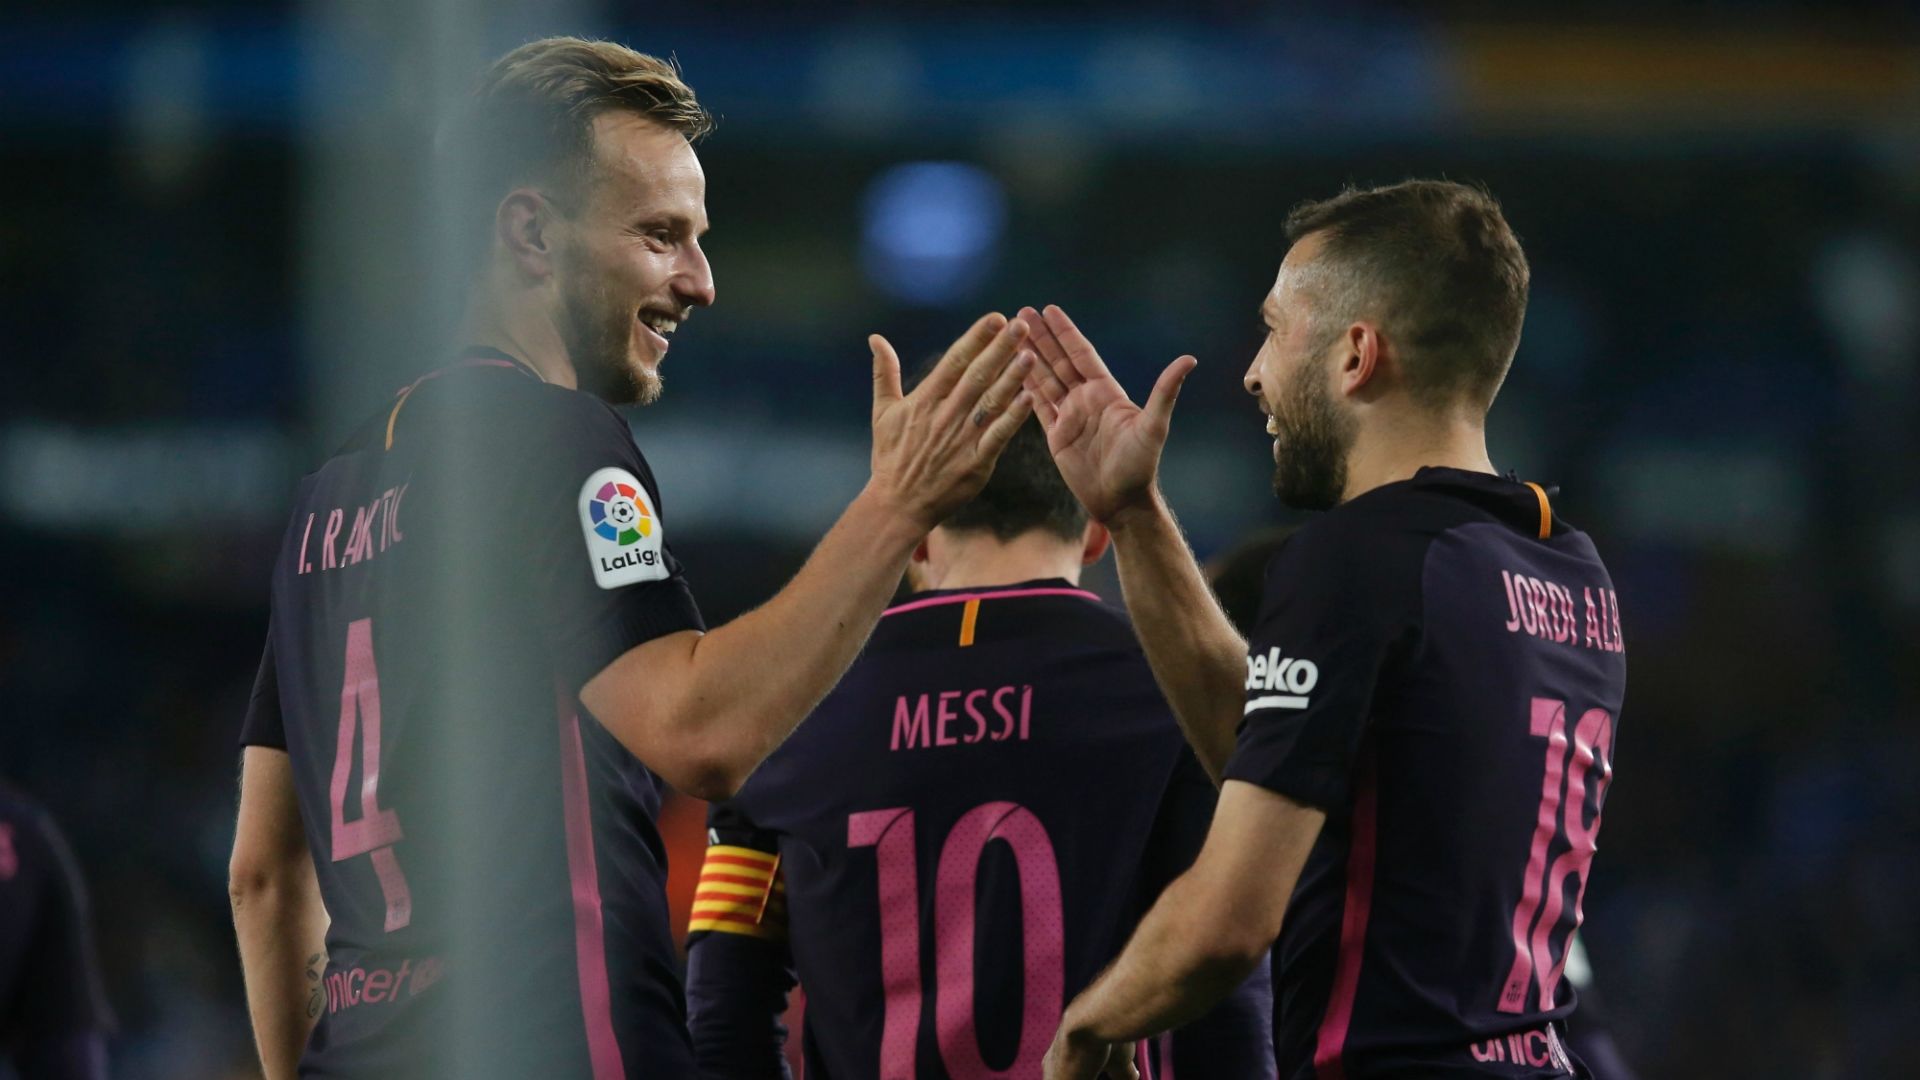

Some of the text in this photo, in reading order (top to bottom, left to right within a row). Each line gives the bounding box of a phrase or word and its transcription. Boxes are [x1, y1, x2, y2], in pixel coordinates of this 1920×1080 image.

[890, 685, 1033, 751] MESSI
[1501, 569, 1578, 646] JORDI
[329, 617, 412, 933] 4
[1496, 696, 1612, 1014] 18
[846, 800, 1066, 1080] 10
